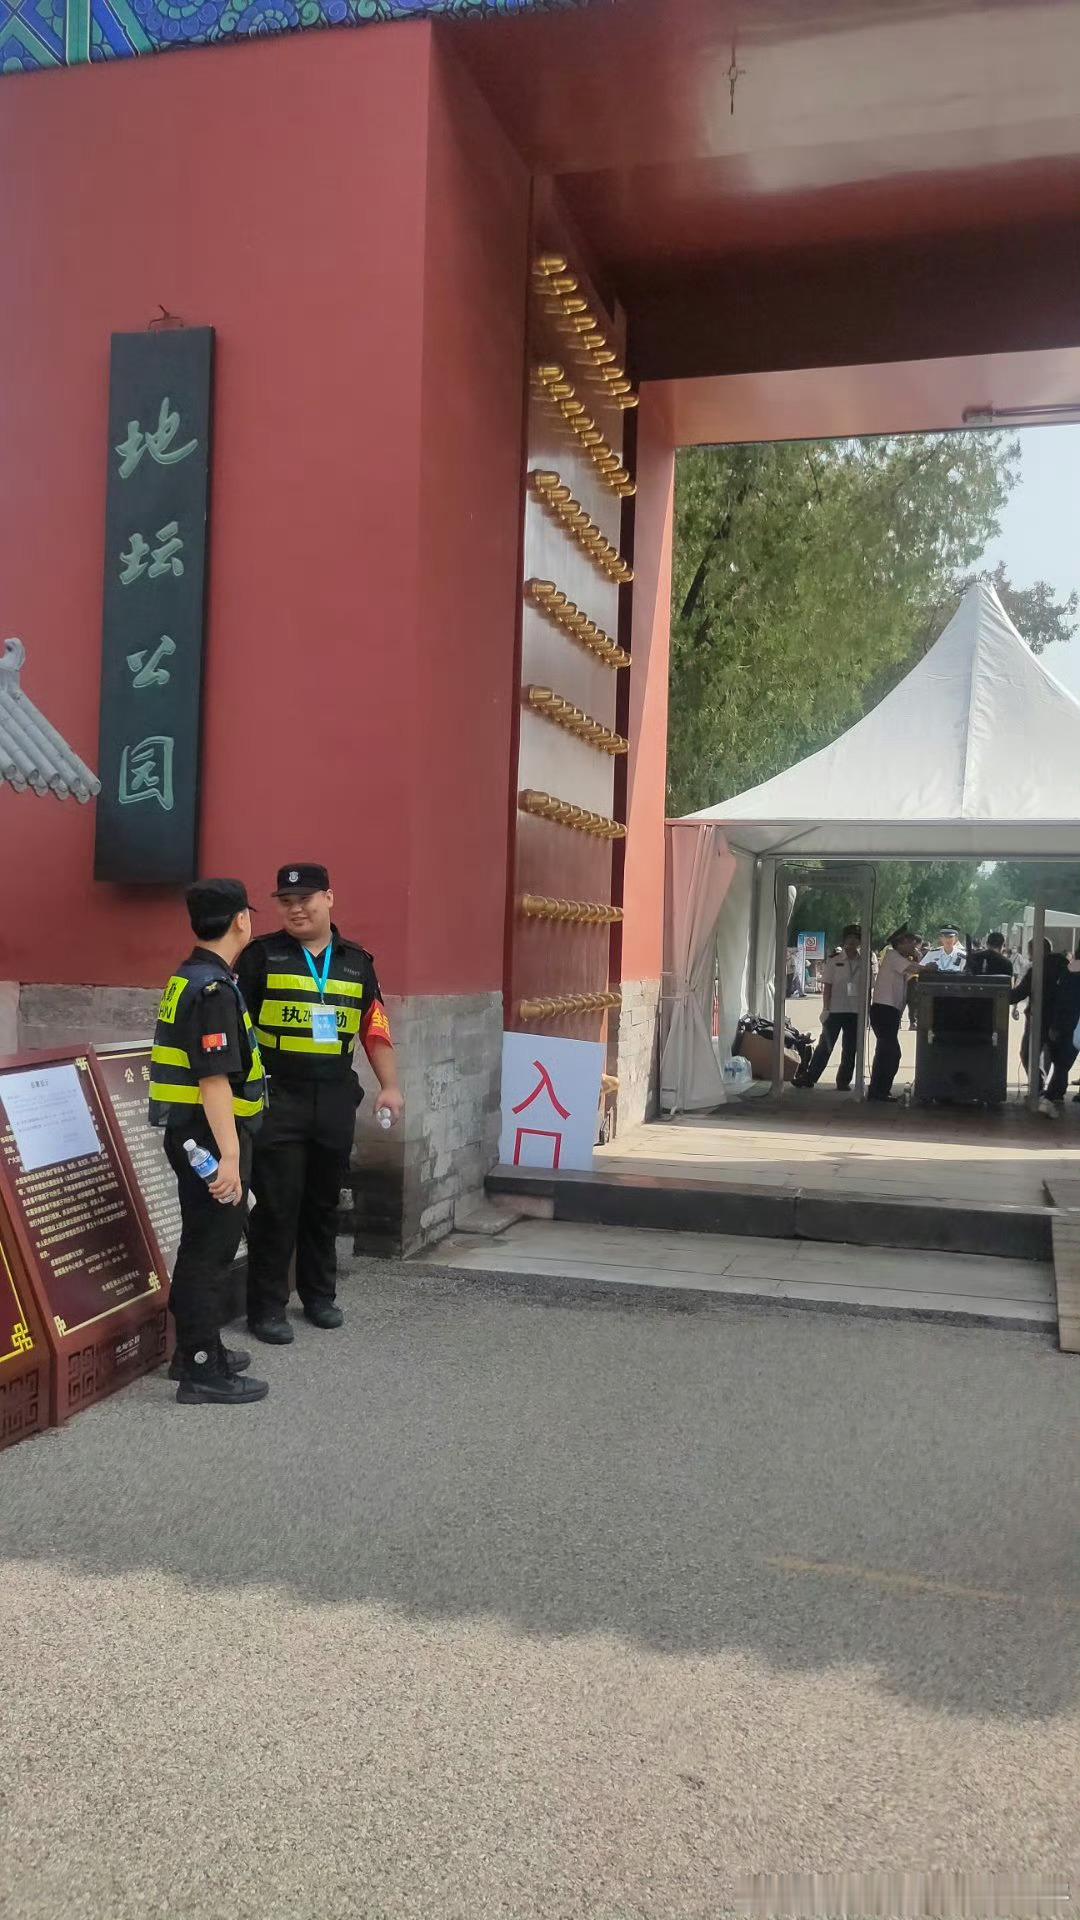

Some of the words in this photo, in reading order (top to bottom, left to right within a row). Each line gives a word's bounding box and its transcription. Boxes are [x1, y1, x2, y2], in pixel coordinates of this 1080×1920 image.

[115, 397, 198, 810] 地坛公园
[281, 1006, 302, 1023] 执
[124, 1065, 151, 1083] 公告
[512, 1060, 572, 1169] 入口
